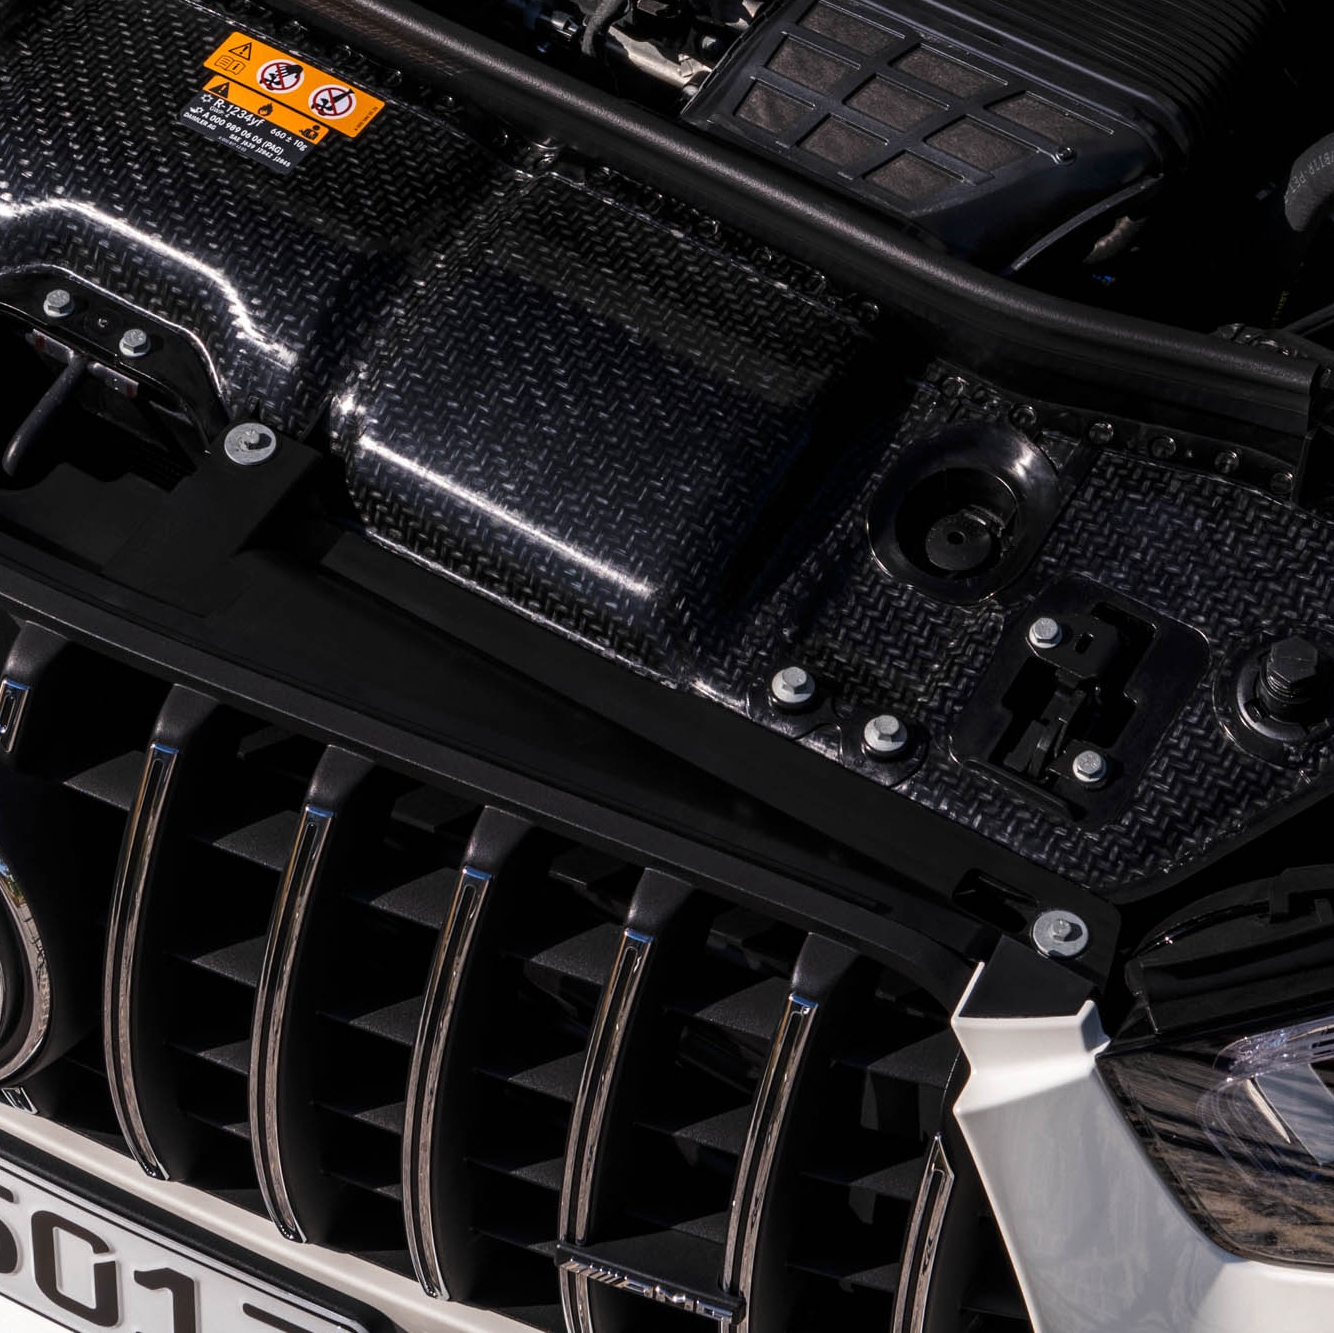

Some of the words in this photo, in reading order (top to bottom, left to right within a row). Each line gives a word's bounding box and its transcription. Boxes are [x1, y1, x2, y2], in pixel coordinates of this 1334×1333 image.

[183, 112, 210, 127] DAIMLER
[207, 122, 217, 131] AG
[214, 98, 265, 127] R-1234yf
[209, 115, 226, 126] 000
[225, 121, 241, 133] 989
[240, 128, 252, 139] 06
[251, 133, 263, 144] 06
[261, 138, 285, 156] (PAG)
[229, 133, 241, 143] SAE
[270, 128, 287, 140] 660
[293, 139, 308, 152] 10g
